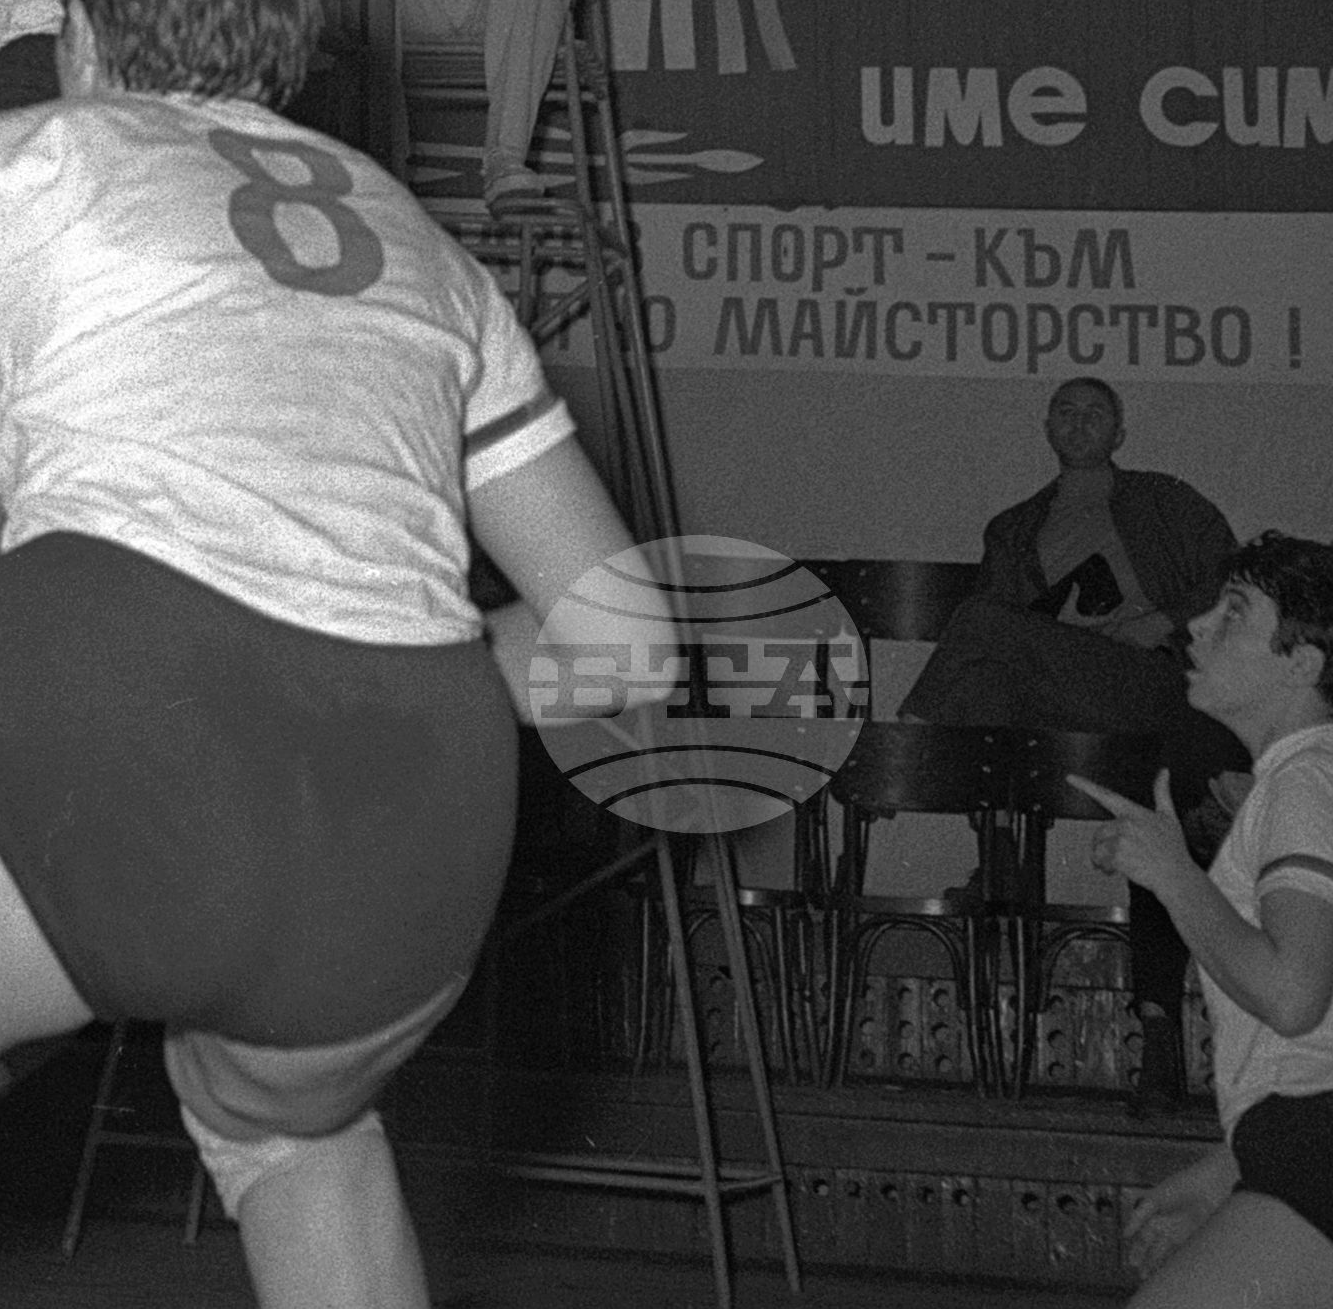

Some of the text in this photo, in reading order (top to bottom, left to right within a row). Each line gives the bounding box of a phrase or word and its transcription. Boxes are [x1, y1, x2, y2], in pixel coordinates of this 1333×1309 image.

[861, 66, 1087, 148] име
[209, 129, 385, 296] 8
[683, 222, 904, 292] СПОРТ
[974, 227, 1136, 290] КЪМ
[713, 287, 1253, 373] МАЙСТОРСТВО
